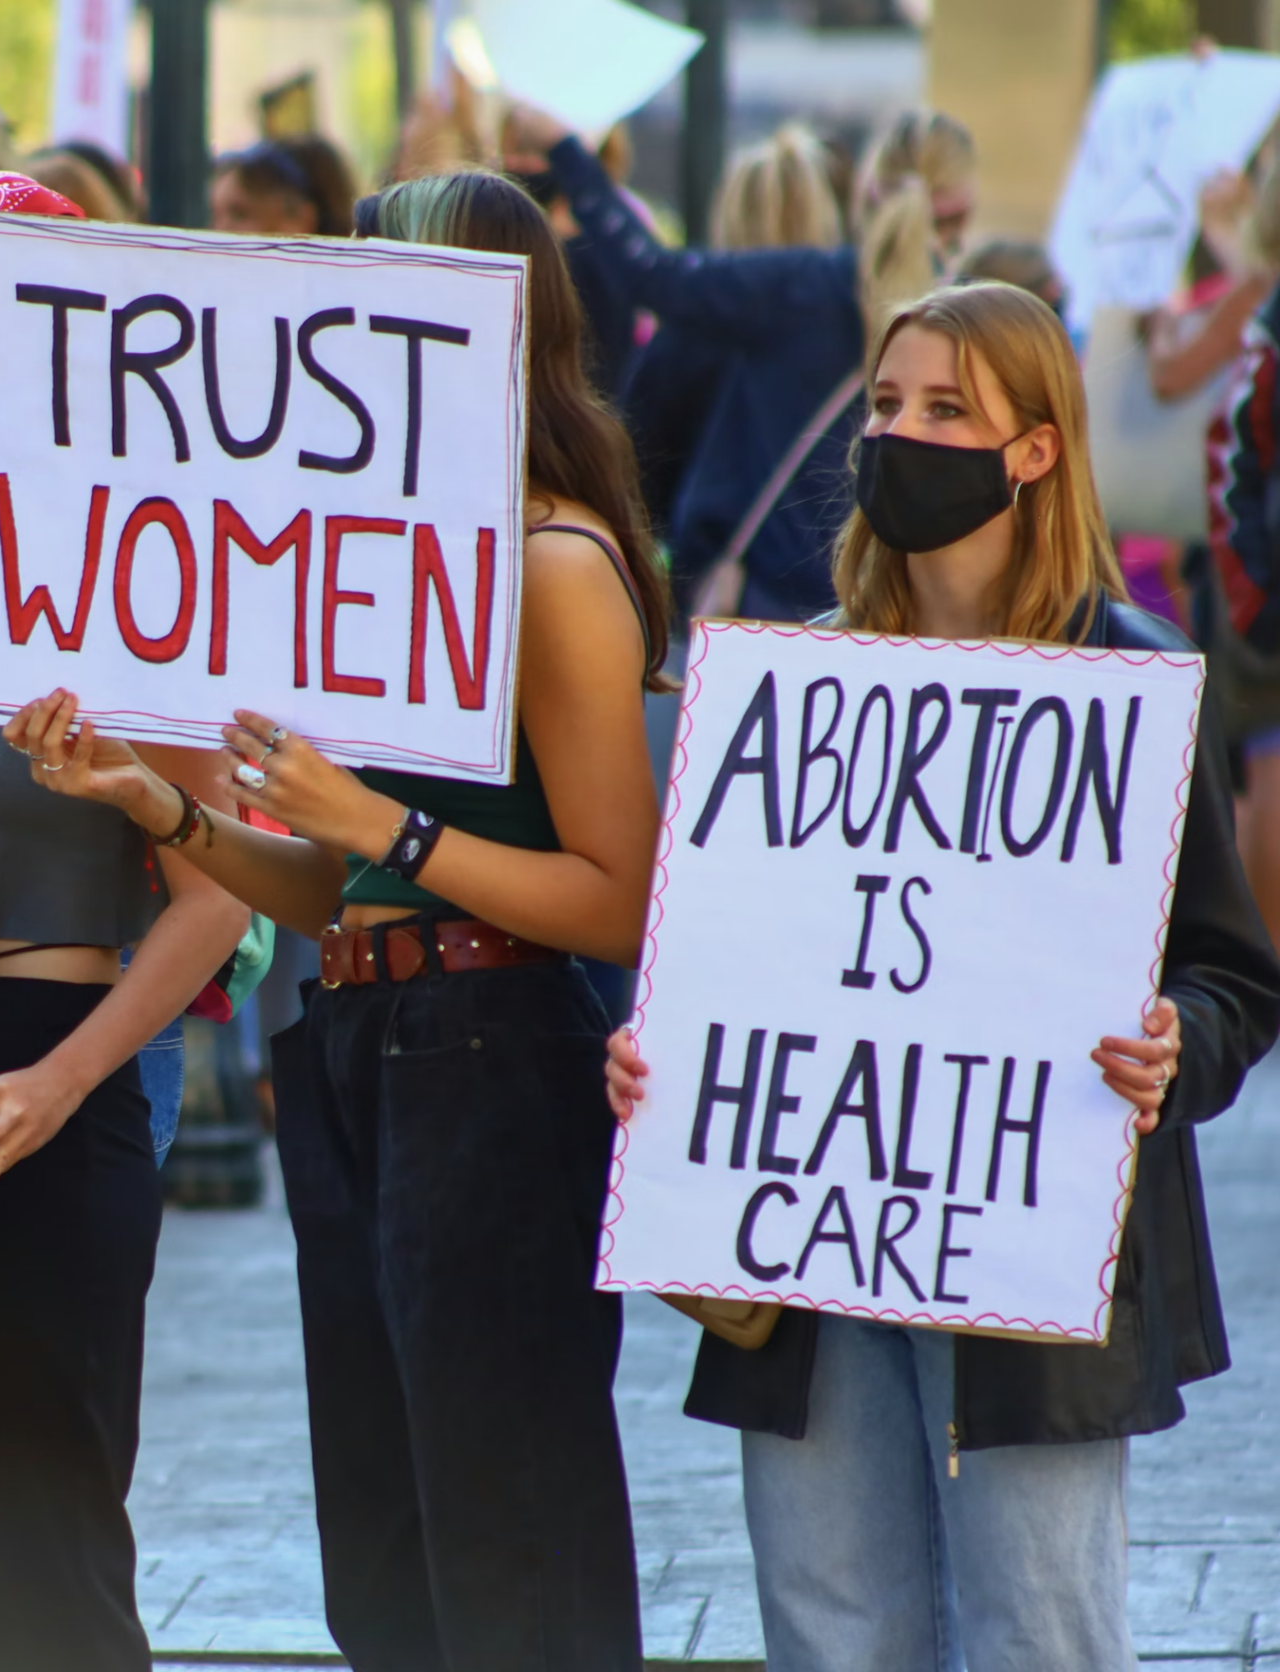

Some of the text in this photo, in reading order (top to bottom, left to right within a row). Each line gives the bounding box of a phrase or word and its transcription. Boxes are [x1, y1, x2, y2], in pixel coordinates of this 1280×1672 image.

[15, 283, 471, 497] TRUST
[689, 670, 1143, 865] ABORTION
[841, 874, 933, 994] IS
[688, 1022, 1053, 1208] HEALTH
[736, 1181, 984, 1305] CARE
